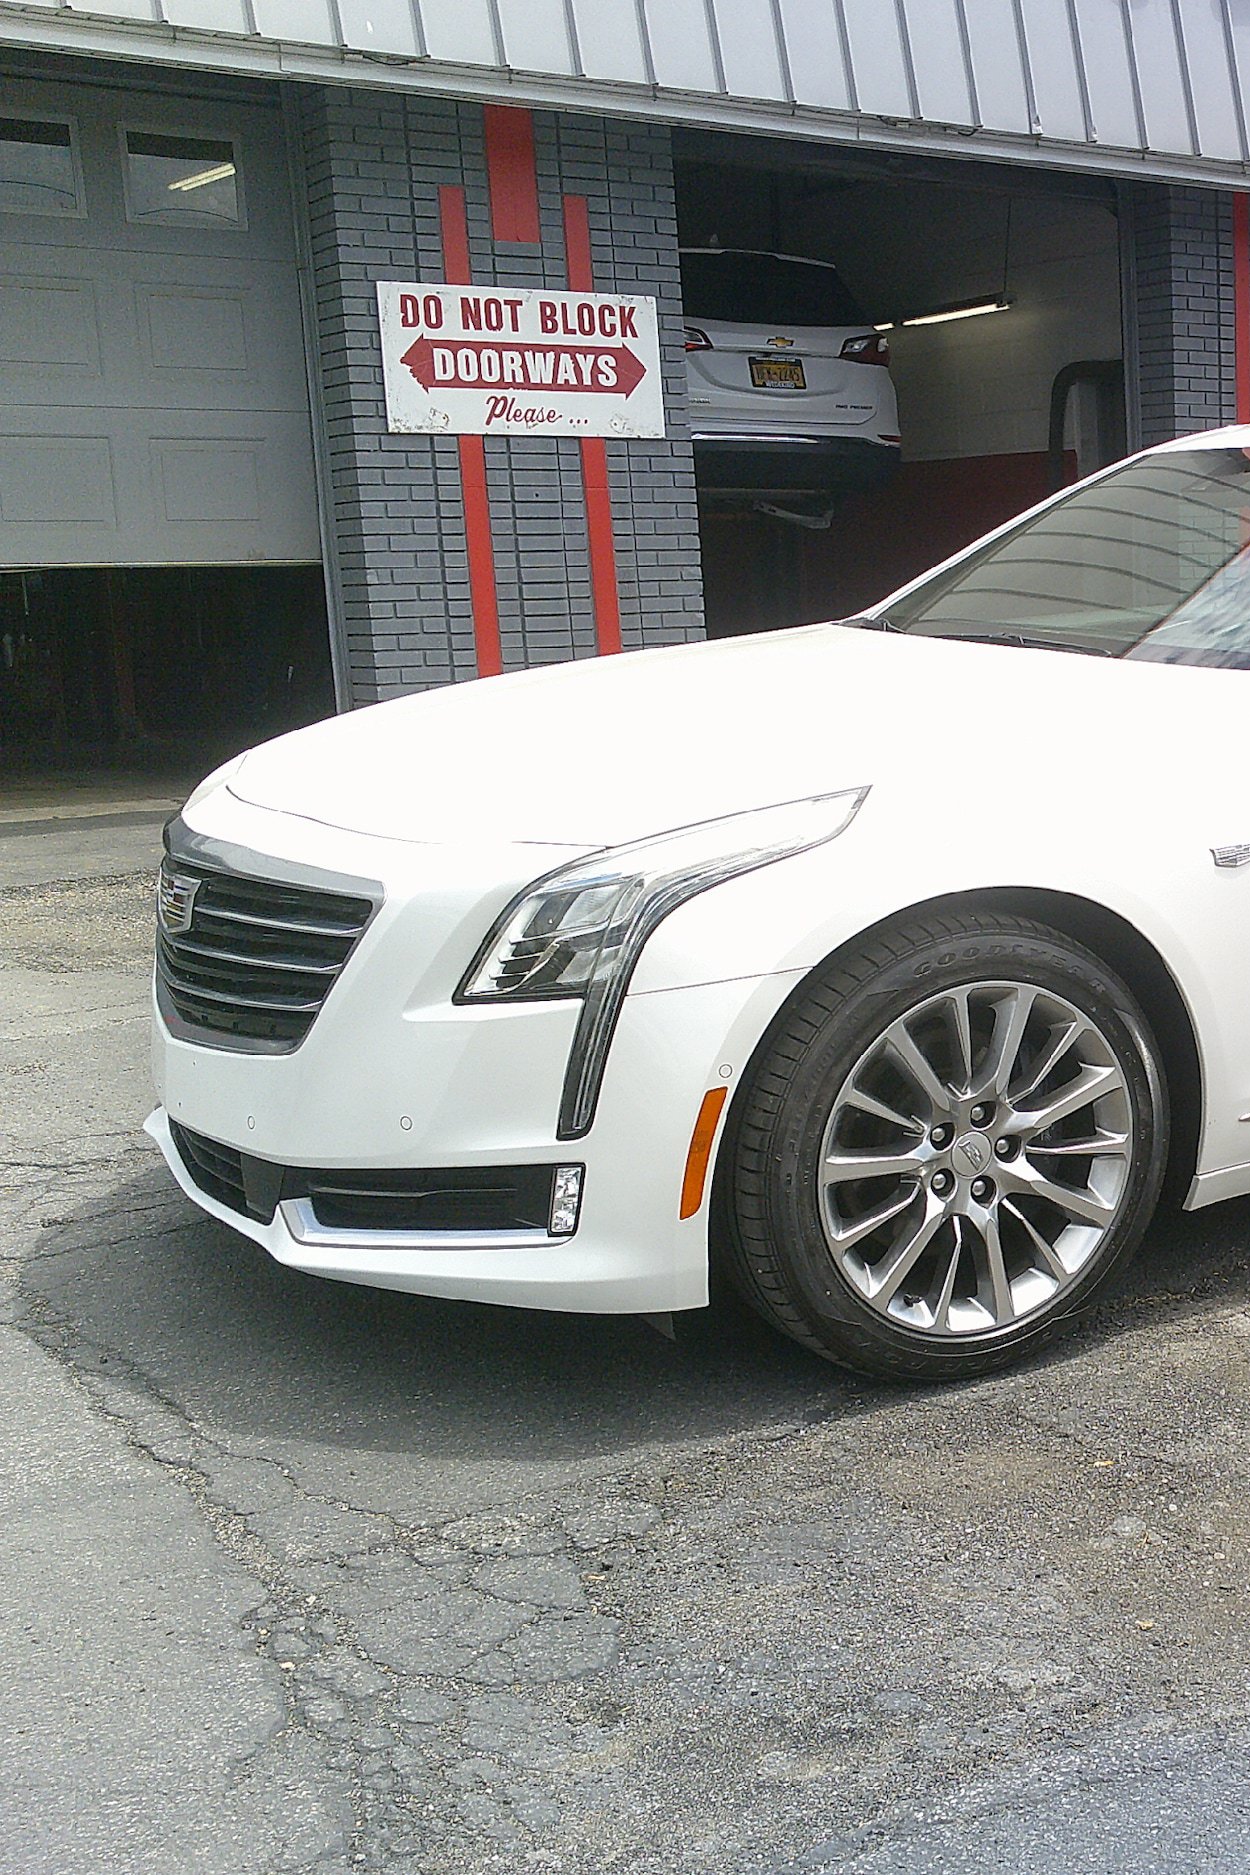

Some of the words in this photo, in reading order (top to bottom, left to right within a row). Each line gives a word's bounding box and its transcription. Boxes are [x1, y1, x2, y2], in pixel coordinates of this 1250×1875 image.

[400, 293, 443, 328] DO
[460, 296, 524, 332] NOT
[539, 301, 639, 338] BLOCK
[432, 347, 618, 388] DOORWAYS
[485, 396, 563, 425] Please
